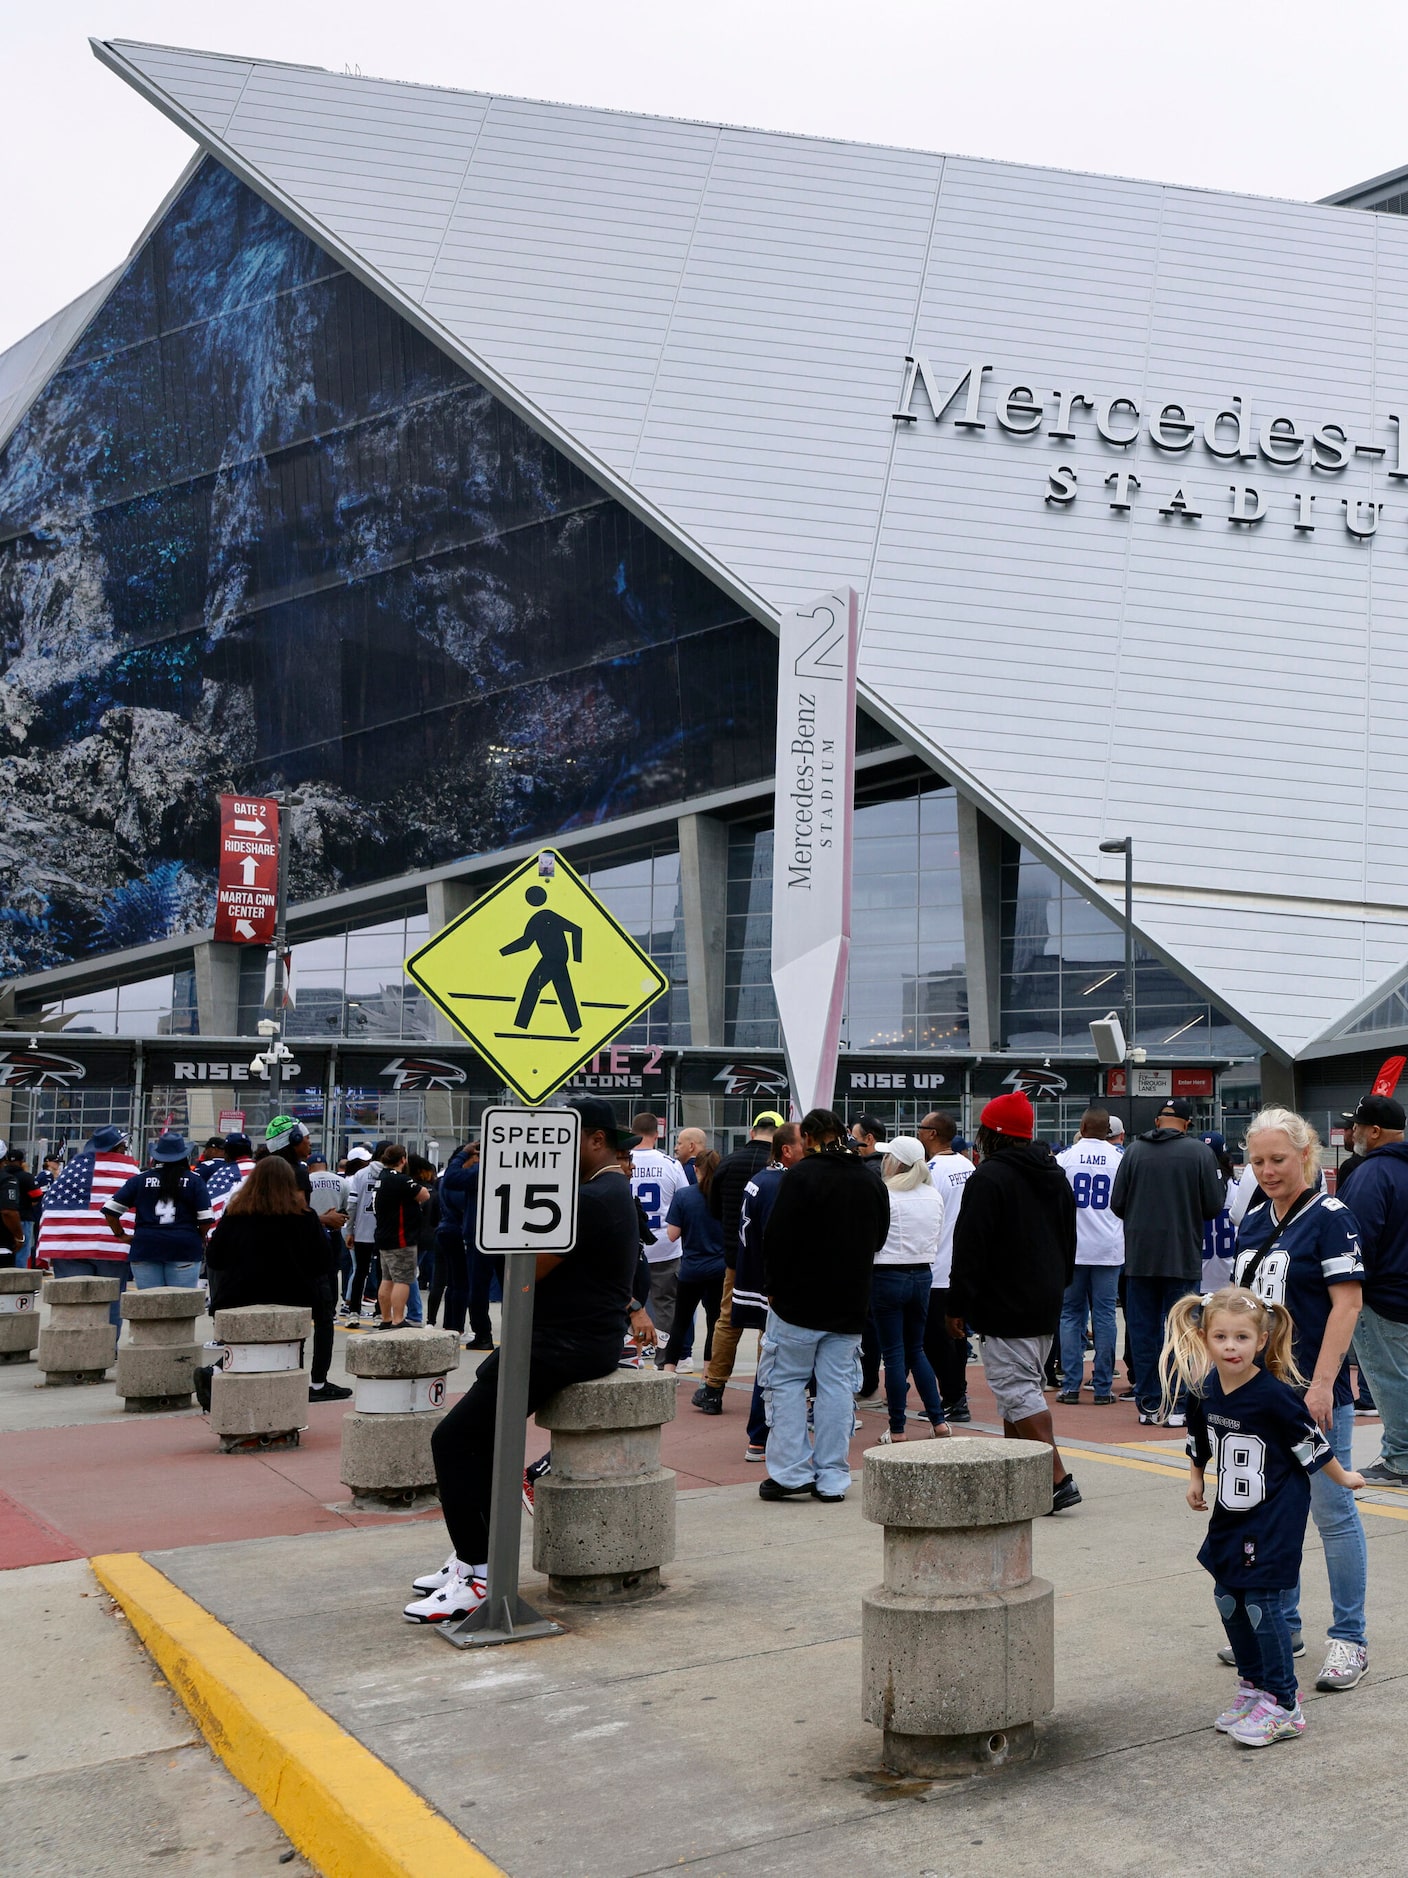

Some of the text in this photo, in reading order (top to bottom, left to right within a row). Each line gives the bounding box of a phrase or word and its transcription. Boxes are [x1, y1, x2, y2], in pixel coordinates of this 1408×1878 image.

[795, 596, 845, 682] 2
[788, 694, 816, 890] Mercedes-Benz
[821, 740, 834, 848] STADIUM
[234, 803, 266, 816] GATE 2
[224, 840, 276, 856] RIDESHARE
[220, 891, 275, 906] MARTA CNN
[228, 905, 265, 918] CENTER
[580, 1044, 663, 1074] TE 2
[173, 1062, 250, 1080] RISE
[564, 1075, 643, 1087] LCONS
[850, 1073, 945, 1089] RISE UP
[491, 1126, 571, 1144] SPEED
[499, 1151, 562, 1169] LIMIT
[1080, 1154, 1107, 1165] LAMB
[1074, 1172, 1111, 1210] 88
[155, 1199, 176, 1224] 4
[494, 1184, 562, 1234] 15
[630, 1183, 661, 1228] 2
